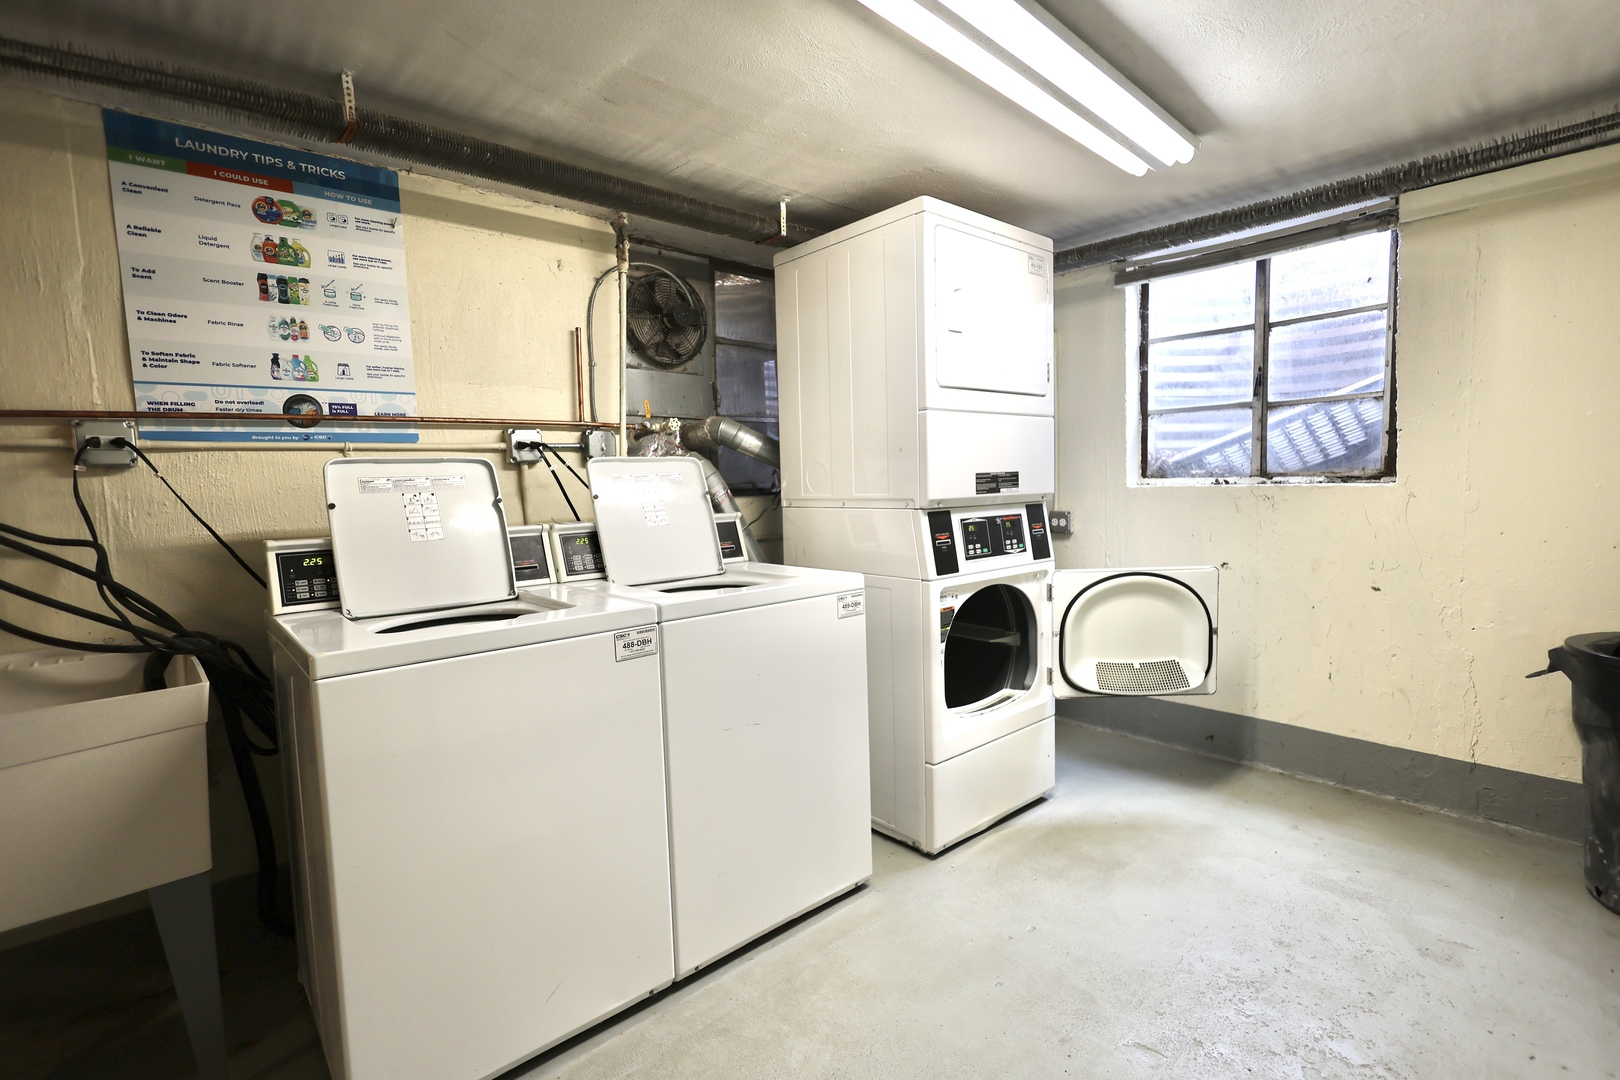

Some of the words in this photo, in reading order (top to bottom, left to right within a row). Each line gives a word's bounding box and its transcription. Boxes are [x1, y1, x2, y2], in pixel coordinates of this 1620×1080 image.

[135, 155, 166, 166] WANT
[175, 138, 248, 160] LAUNDRY
[252, 153, 283, 168] TIPS
[287, 160, 296, 170] &
[299, 162, 346, 180] TRICKS
[219, 171, 250, 182] COULD
[129, 182, 168, 193] Convenient
[325, 191, 344, 199] HOW
[194, 196, 225, 205] Detergent
[134, 225, 161, 233] Reliable
[198, 234, 217, 242] Liquid
[199, 241, 230, 249] Detergent
[303, 557, 323, 566] 2.25
[622, 638, 652, 649] 488-DBH
